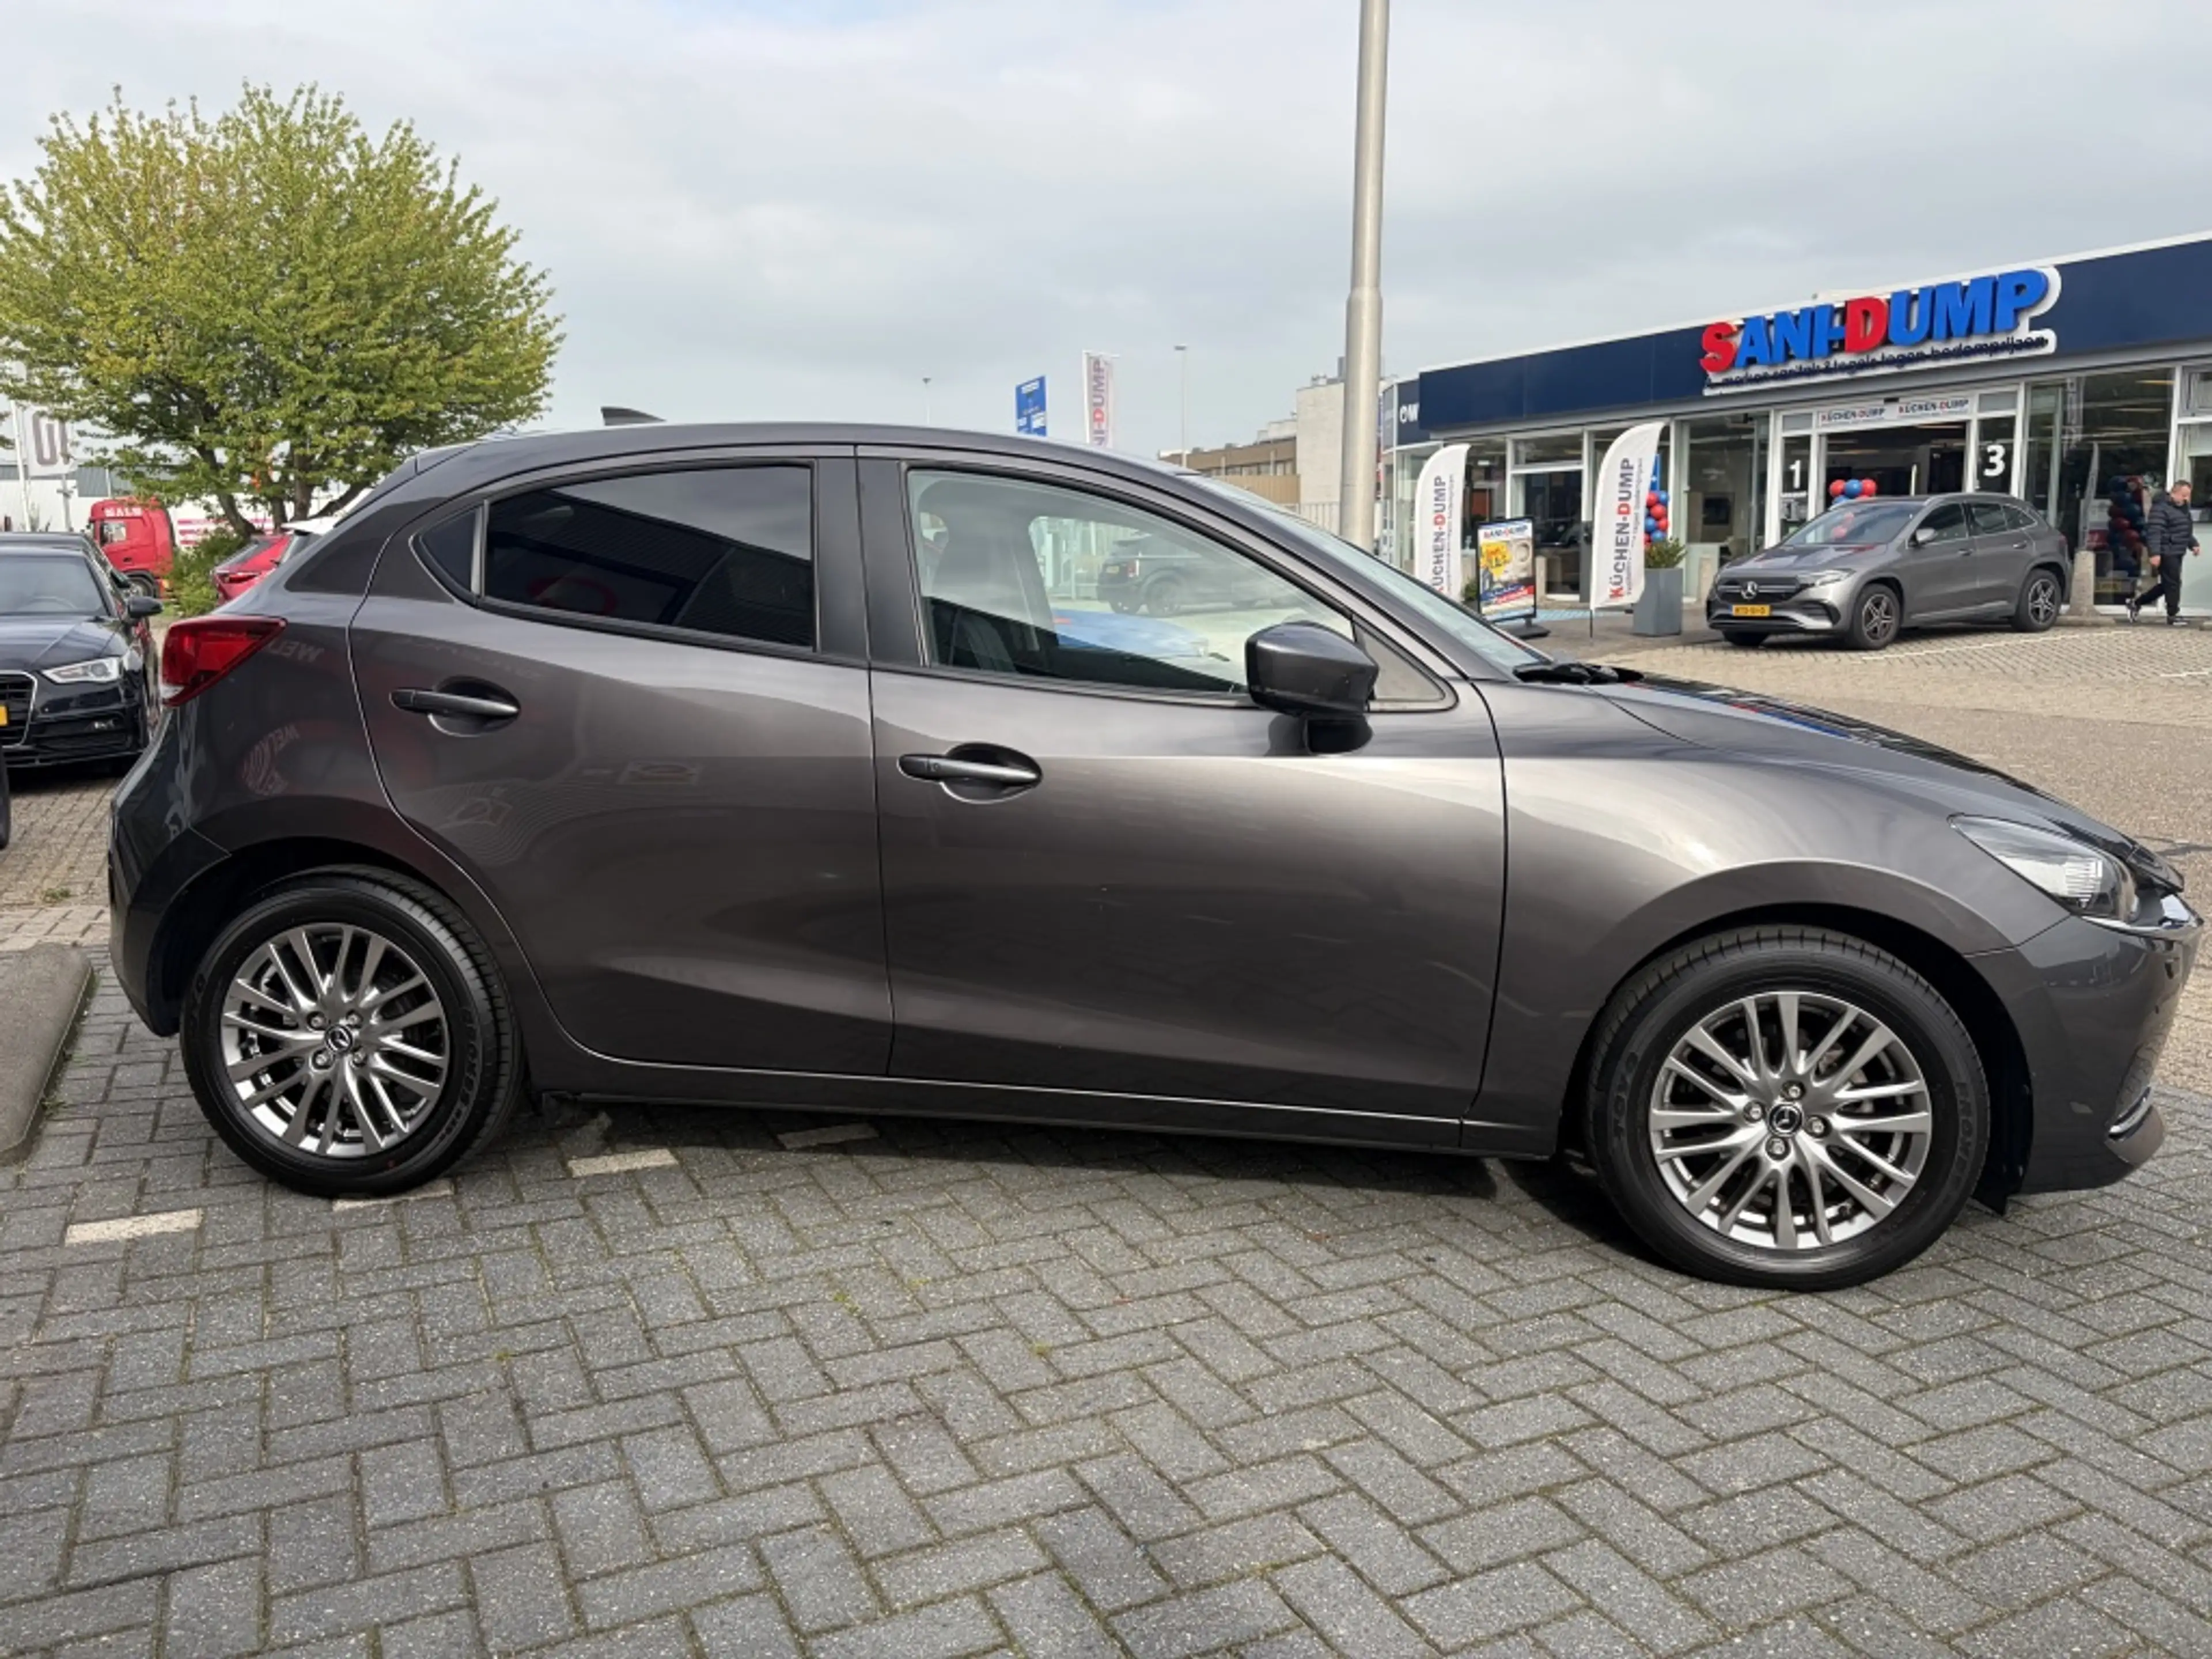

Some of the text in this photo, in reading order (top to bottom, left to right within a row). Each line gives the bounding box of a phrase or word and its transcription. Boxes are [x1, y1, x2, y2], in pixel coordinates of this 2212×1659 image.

[1700, 270, 2048, 372] SANI-DUMP
[1789, 460, 1801, 488] 1
[1984, 445, 2006, 476] 3
[1609, 457, 1634, 599] KÜCHEN-DUMP
